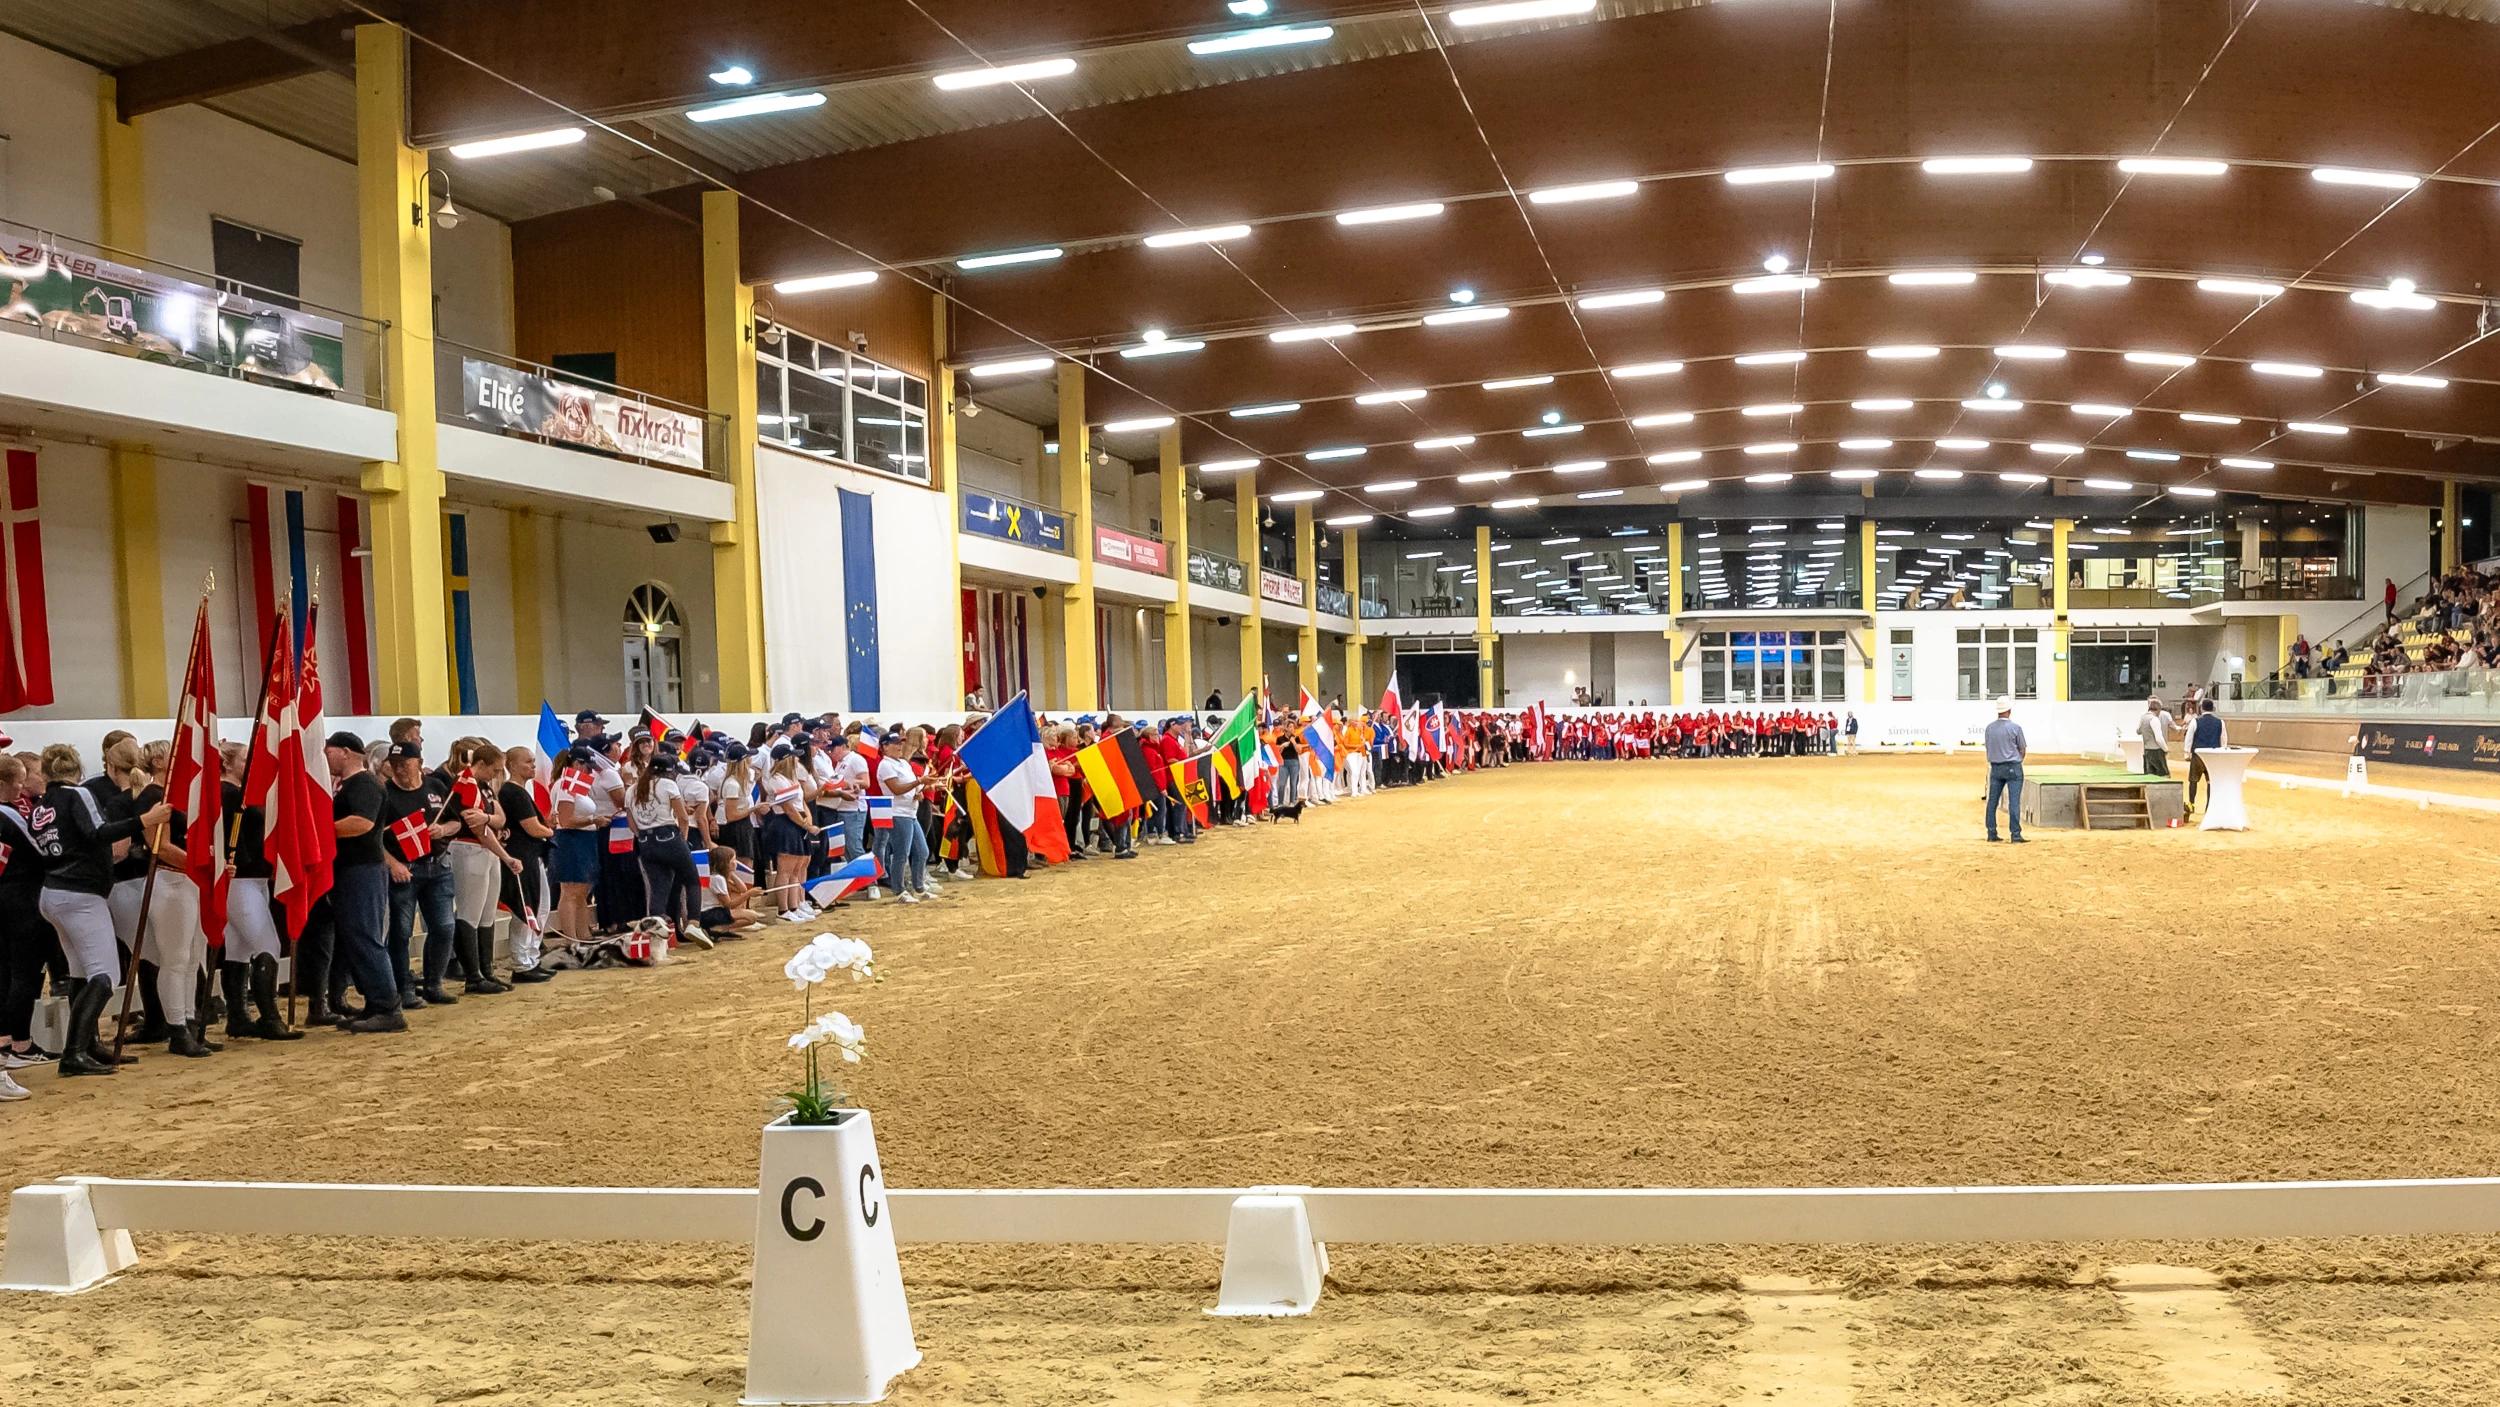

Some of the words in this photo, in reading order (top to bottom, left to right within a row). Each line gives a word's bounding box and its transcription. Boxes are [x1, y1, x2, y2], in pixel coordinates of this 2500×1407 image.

[478, 376, 525, 415] Elité
[617, 404, 686, 448] fixkraft
[2356, 763, 2363, 773] E
[780, 1176, 826, 1242] C
[859, 1163, 879, 1228] C
